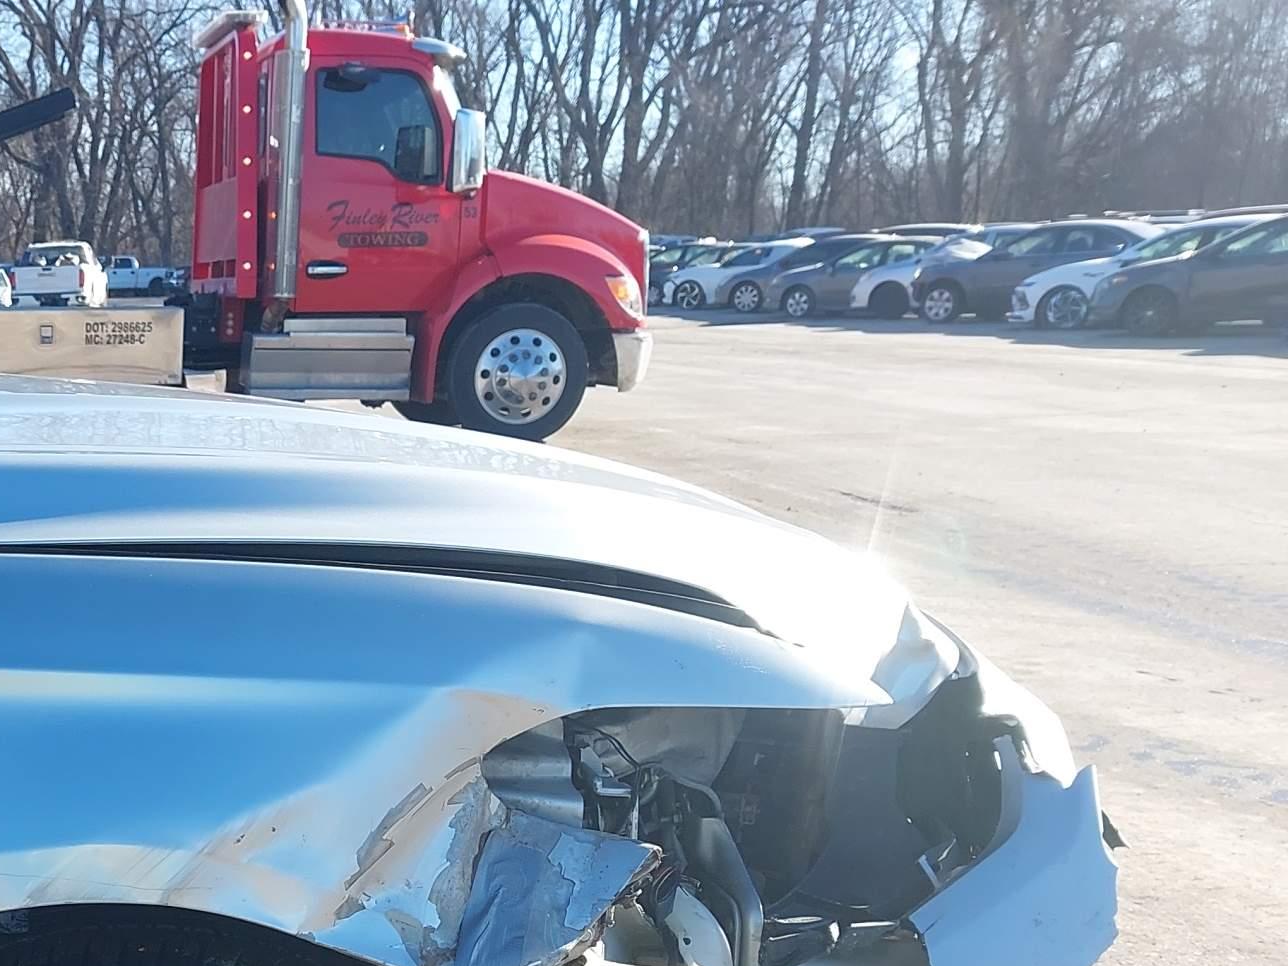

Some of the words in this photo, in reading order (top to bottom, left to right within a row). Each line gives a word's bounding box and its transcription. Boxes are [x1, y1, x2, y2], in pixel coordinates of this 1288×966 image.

[327, 200, 387, 232] Finley
[391, 202, 440, 230] River
[344, 233, 420, 246] TOWING
[85, 322, 109, 333] DOT:
[85, 334, 103, 345] MC:
[106, 334, 145, 345] 27248-C
